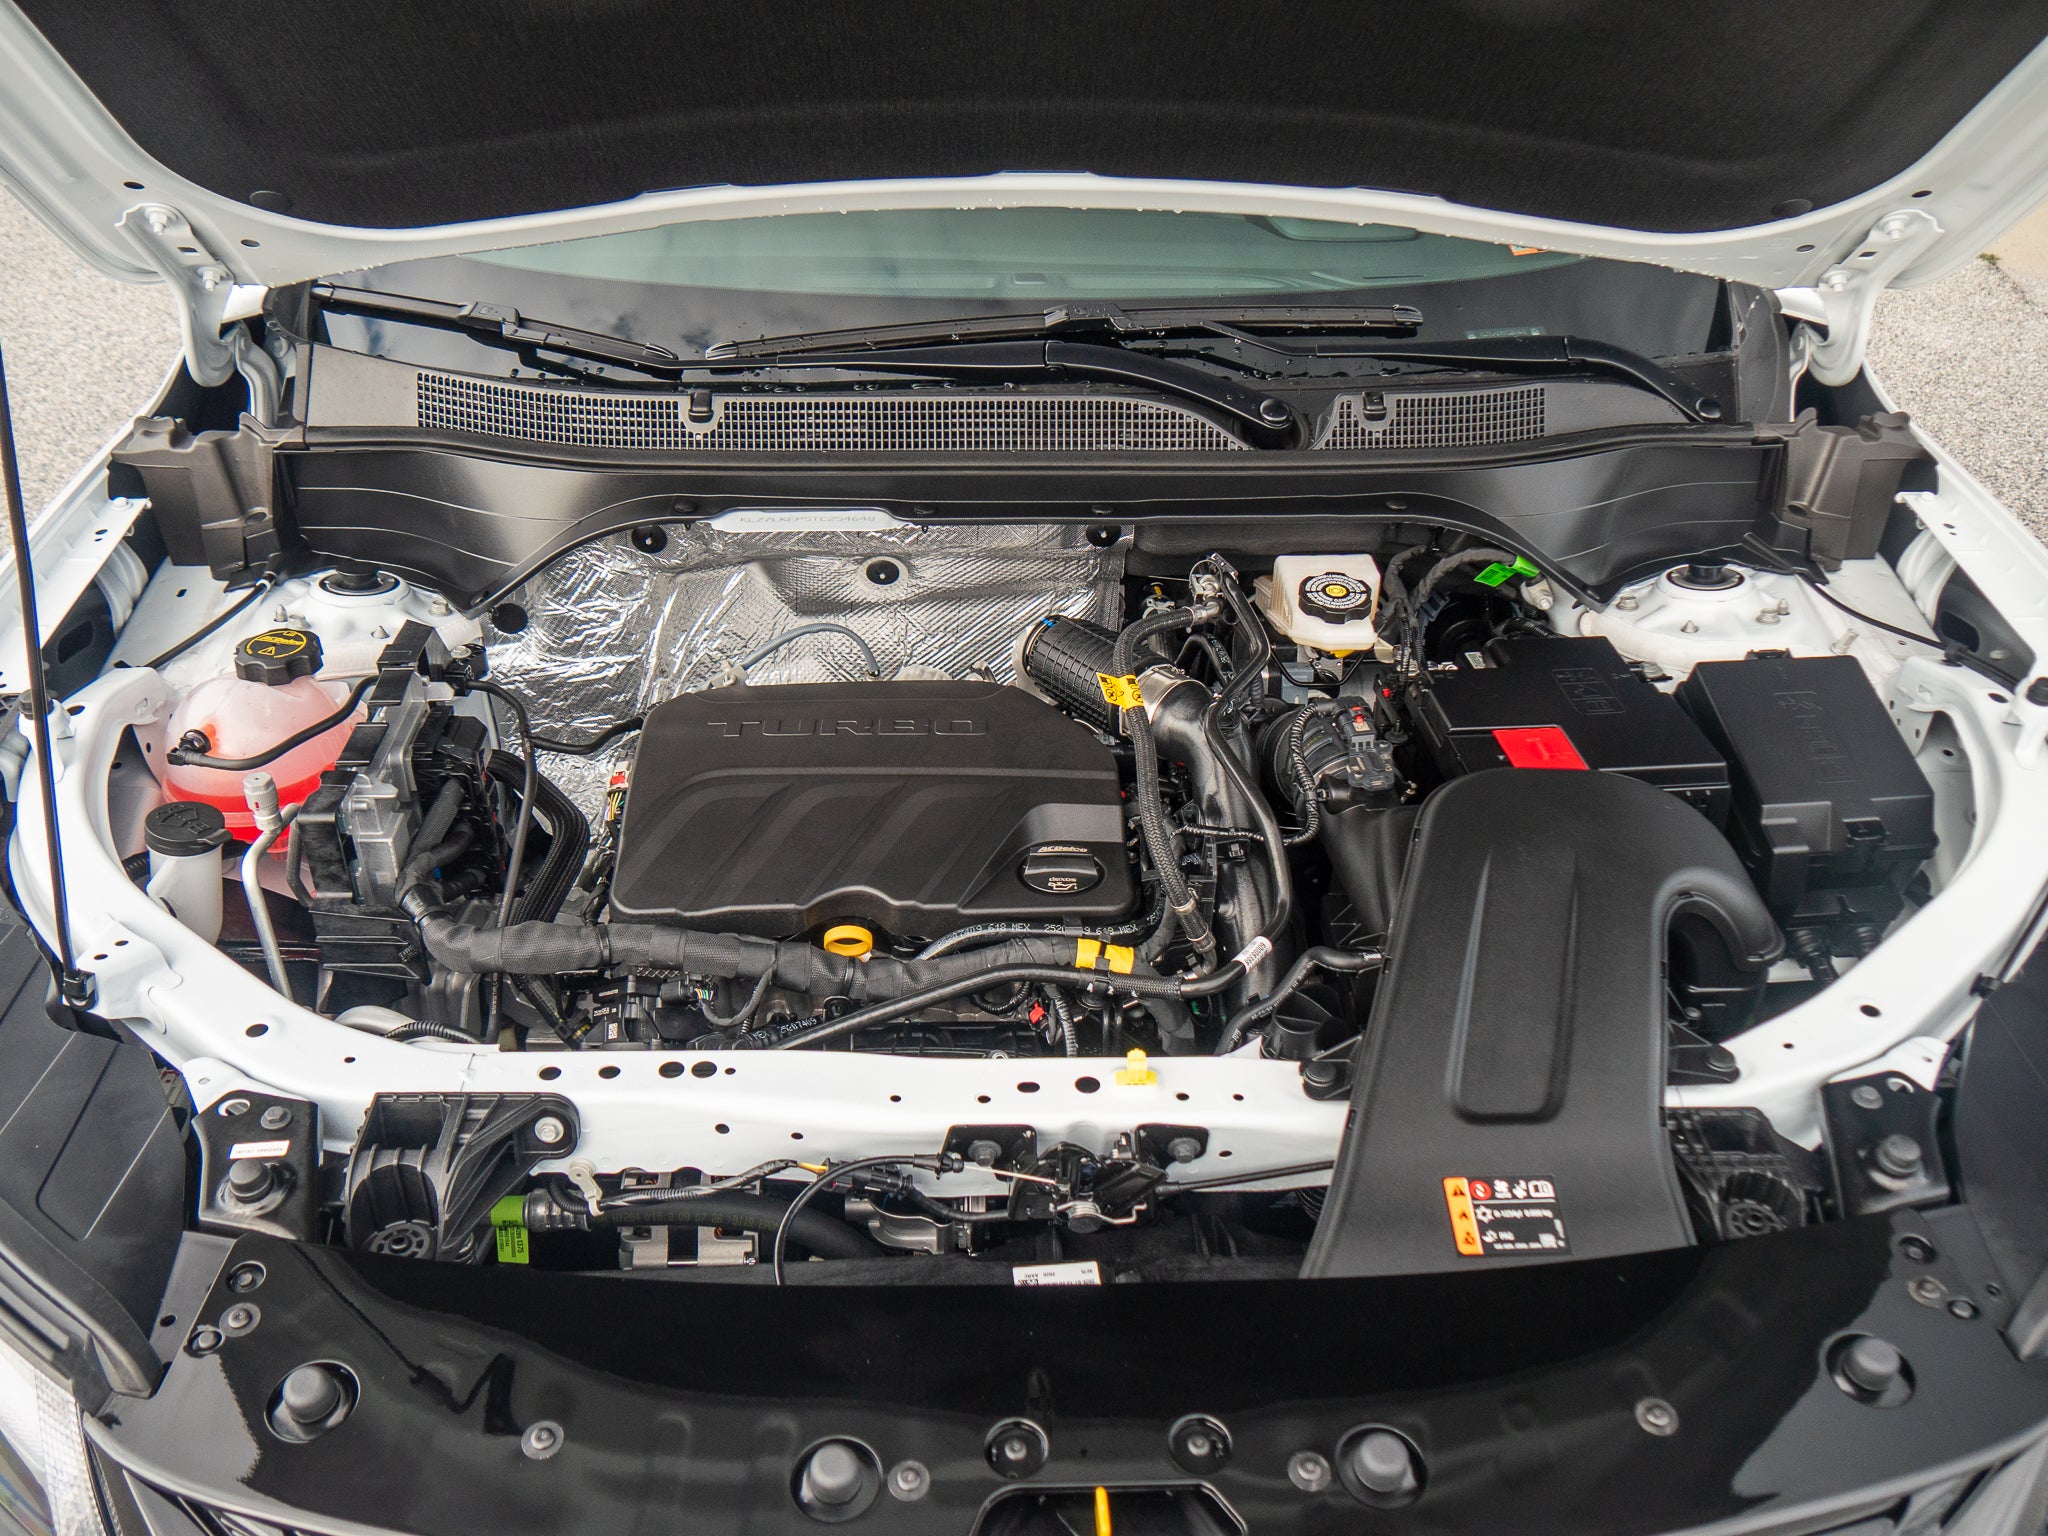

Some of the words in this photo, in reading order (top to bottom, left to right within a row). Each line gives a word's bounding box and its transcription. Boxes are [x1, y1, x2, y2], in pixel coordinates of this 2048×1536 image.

[707, 719, 988, 737] TURBO
[1011, 923, 1030, 931] MEX
[1118, 923, 1139, 935] MEX
